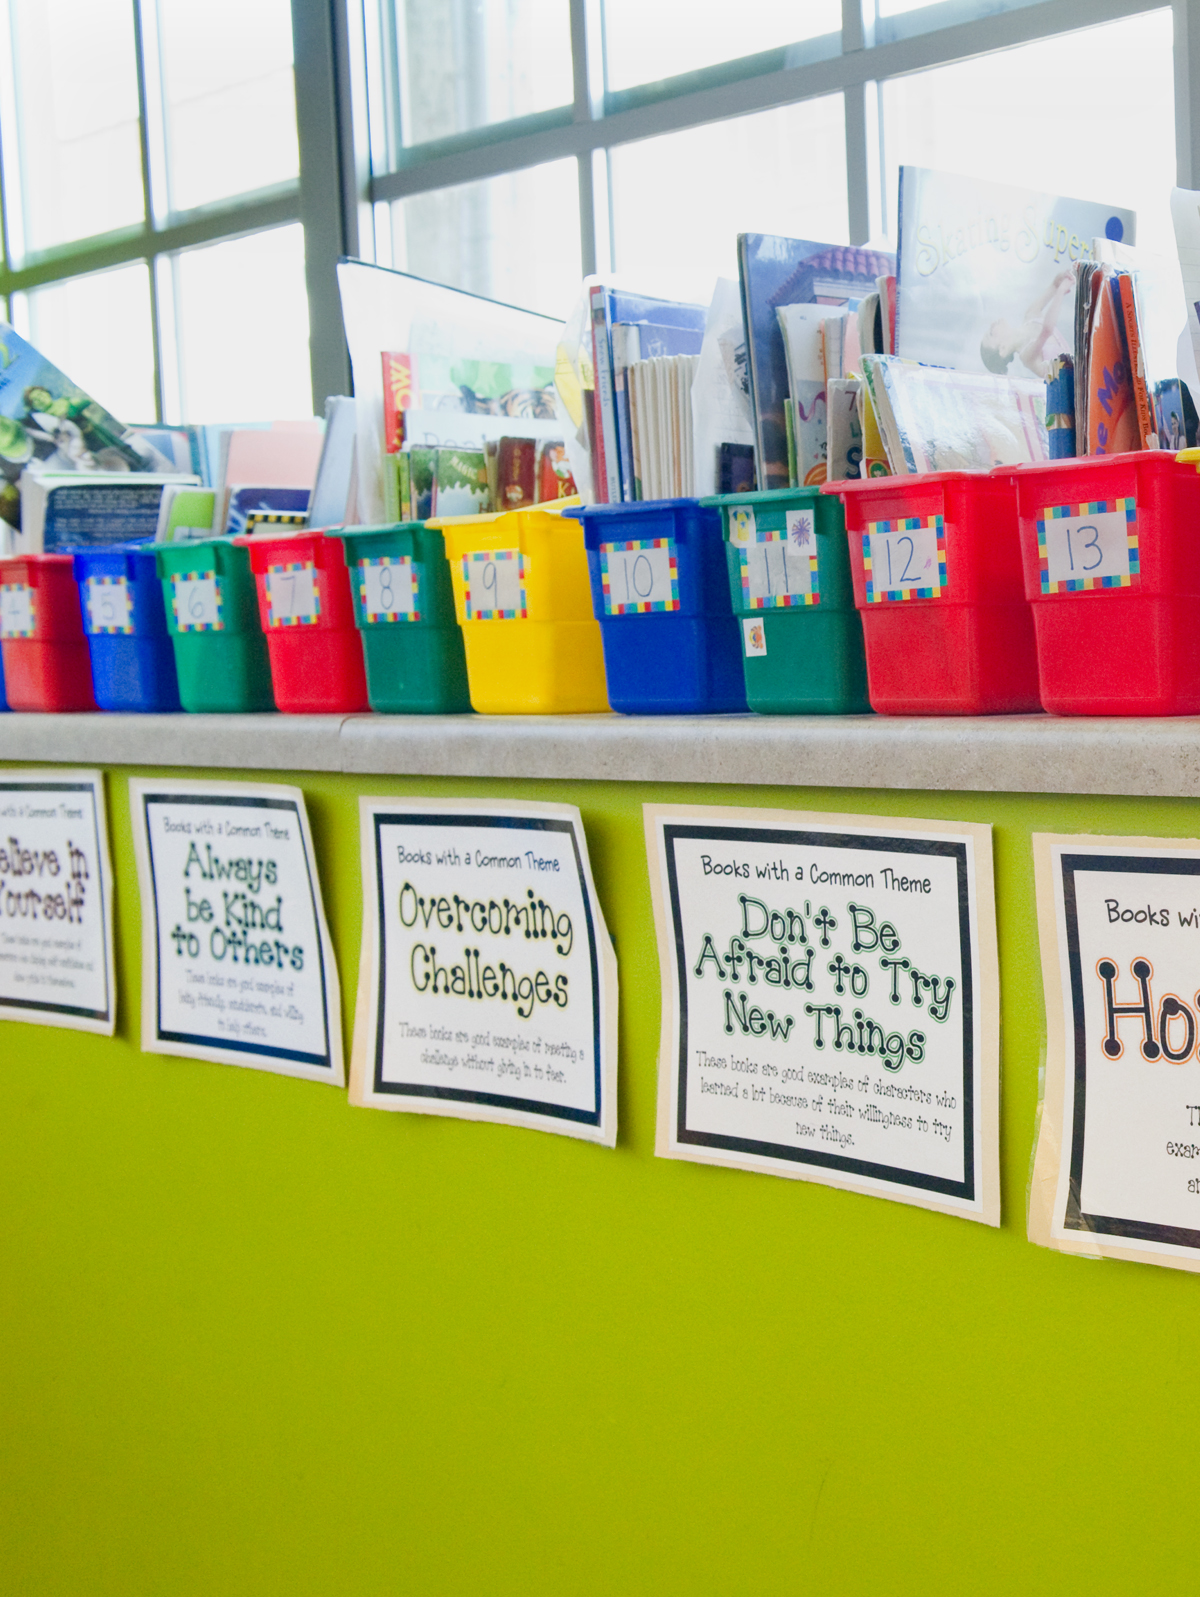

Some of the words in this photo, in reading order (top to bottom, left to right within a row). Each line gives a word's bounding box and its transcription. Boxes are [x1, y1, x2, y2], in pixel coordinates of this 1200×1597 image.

[764, 546, 790, 594] 11
[885, 536, 922, 585] 12
[1066, 525, 1103, 570] 13
[280, 575, 296, 615] 7
[378, 566, 395, 610] 8
[482, 561, 498, 608] 9
[623, 555, 654, 600] 10
[100, 592, 115, 621] 5
[187, 586, 205, 619] 6
[163, 816, 192, 833] Books
[195, 819, 215, 836] with
[225, 819, 261, 838] Common
[264, 822, 290, 841] Theme
[0, 836, 61, 877] elieve
[67, 840, 89, 880] in
[184, 841, 278, 894] Always
[397, 846, 432, 865] Books
[436, 847, 461, 867] with
[464, 852, 471, 865] a
[475, 849, 522, 869] Common
[525, 851, 560, 873] Theme
[701, 855, 750, 878] Books
[755, 860, 789, 882] with
[795, 866, 804, 881] a
[810, 863, 874, 888] Common
[880, 867, 932, 894] Theme
[0, 880, 85, 924] ourself
[184, 887, 215, 923] be
[223, 891, 284, 933] Kind
[399, 882, 574, 956] Overcoming
[738, 893, 836, 946] Don't
[848, 902, 900, 952] Be
[1104, 898, 1170, 925] Books
[171, 924, 200, 958] to
[210, 926, 305, 972] Others
[410, 944, 569, 1019] Challenges
[694, 935, 815, 990] Afraid
[829, 956, 868, 996] to
[881, 958, 955, 1020] Try
[399, 1022, 427, 1038] These
[430, 1024, 452, 1041] books
[472, 1031, 490, 1048] good
[724, 991, 793, 1040] New
[805, 1004, 926, 1070] Things
[462, 1053, 494, 1072] without
[497, 1059, 521, 1080] giving
[534, 1064, 543, 1079] to
[696, 1051, 727, 1069] These
[731, 1057, 758, 1074] books
[762, 1063, 779, 1077] are
[782, 1066, 804, 1084] good
[808, 1071, 854, 1092] examples
[857, 1075, 869, 1093] of
[873, 1079, 932, 1105] characters
[936, 1090, 956, 1109] who
[700, 1077, 739, 1098] learned
[742, 1088, 749, 1099] a
[751, 1084, 766, 1100] lot
[769, 1087, 808, 1108] because
[812, 1094, 824, 1112] of
[827, 1097, 855, 1118] their
[858, 1104, 912, 1129] willingness
[916, 1115, 929, 1133] to
[932, 1118, 952, 1142] try
[796, 1122, 815, 1137] new
[820, 1124, 855, 1149] things.
